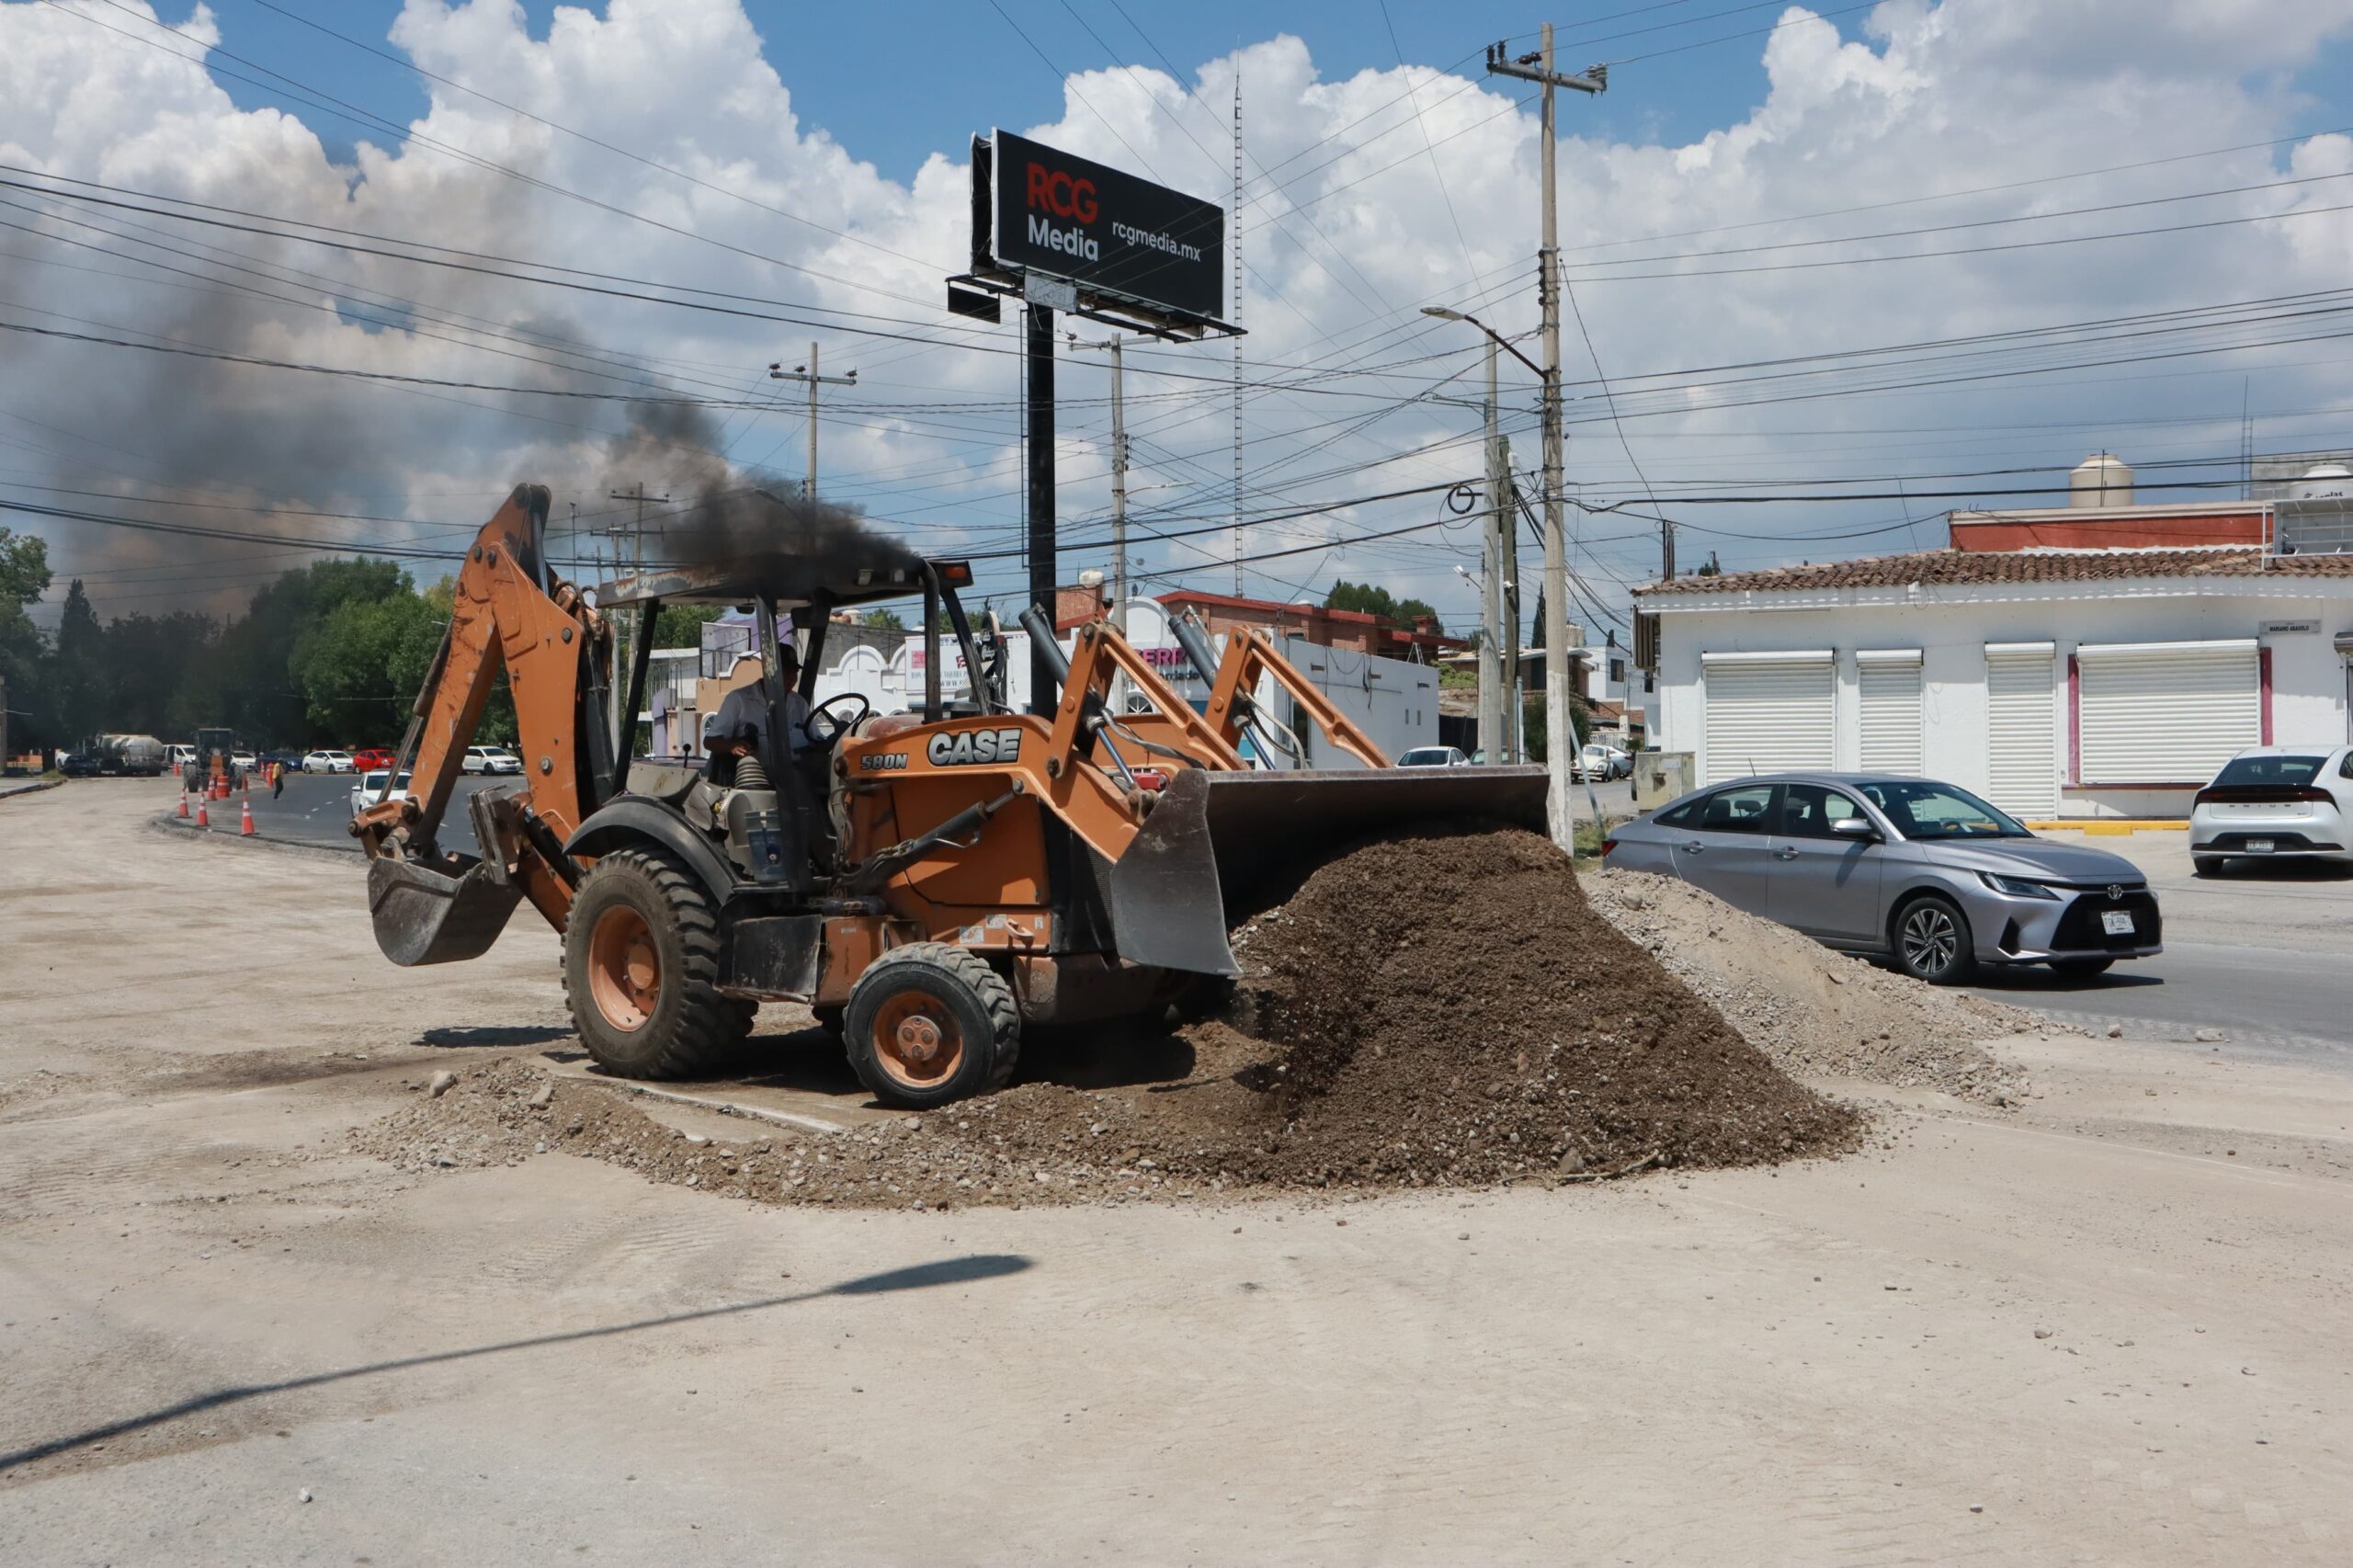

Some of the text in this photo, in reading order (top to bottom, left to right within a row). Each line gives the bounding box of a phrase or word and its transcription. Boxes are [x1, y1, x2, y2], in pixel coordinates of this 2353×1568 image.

[1027, 161, 1099, 224] RCG
[1028, 214, 1099, 262] Media
[1112, 221, 1201, 263] rcgmedia.mx
[860, 753, 909, 771] 580N
[926, 728, 1022, 767] CASE
